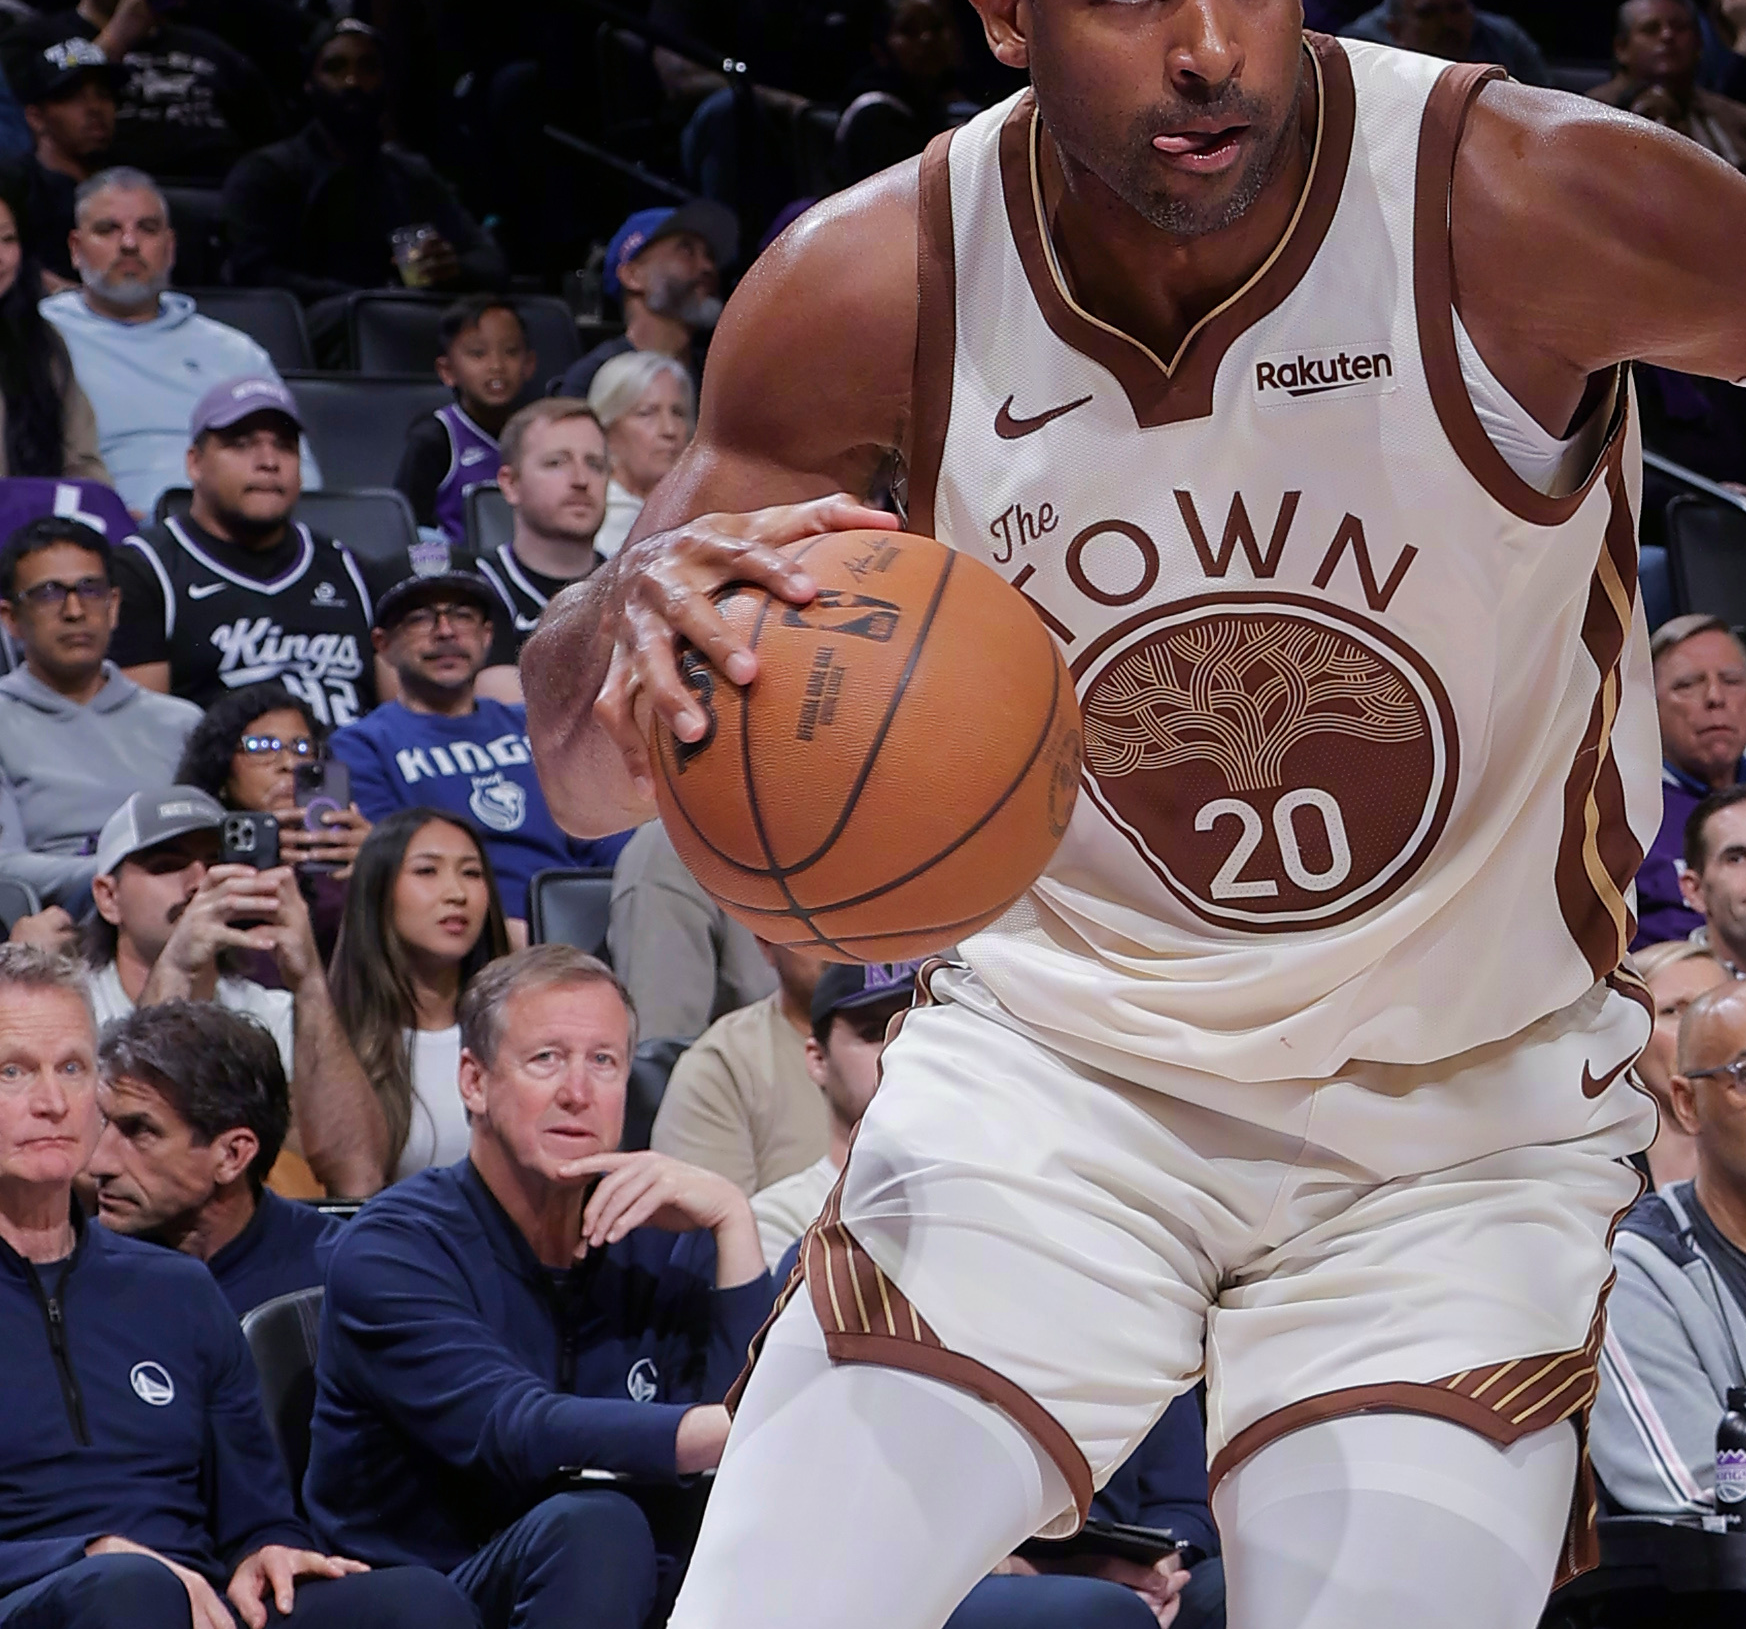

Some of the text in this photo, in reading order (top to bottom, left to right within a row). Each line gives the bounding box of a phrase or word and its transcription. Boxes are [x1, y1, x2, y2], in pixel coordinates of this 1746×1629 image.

[1256, 349, 1393, 397] Rakuten
[990, 497, 1060, 563] The
[210, 617, 363, 688] Kings
[281, 673, 360, 727] 42
[395, 734, 532, 784] KING
[1194, 787, 1353, 900] 20
